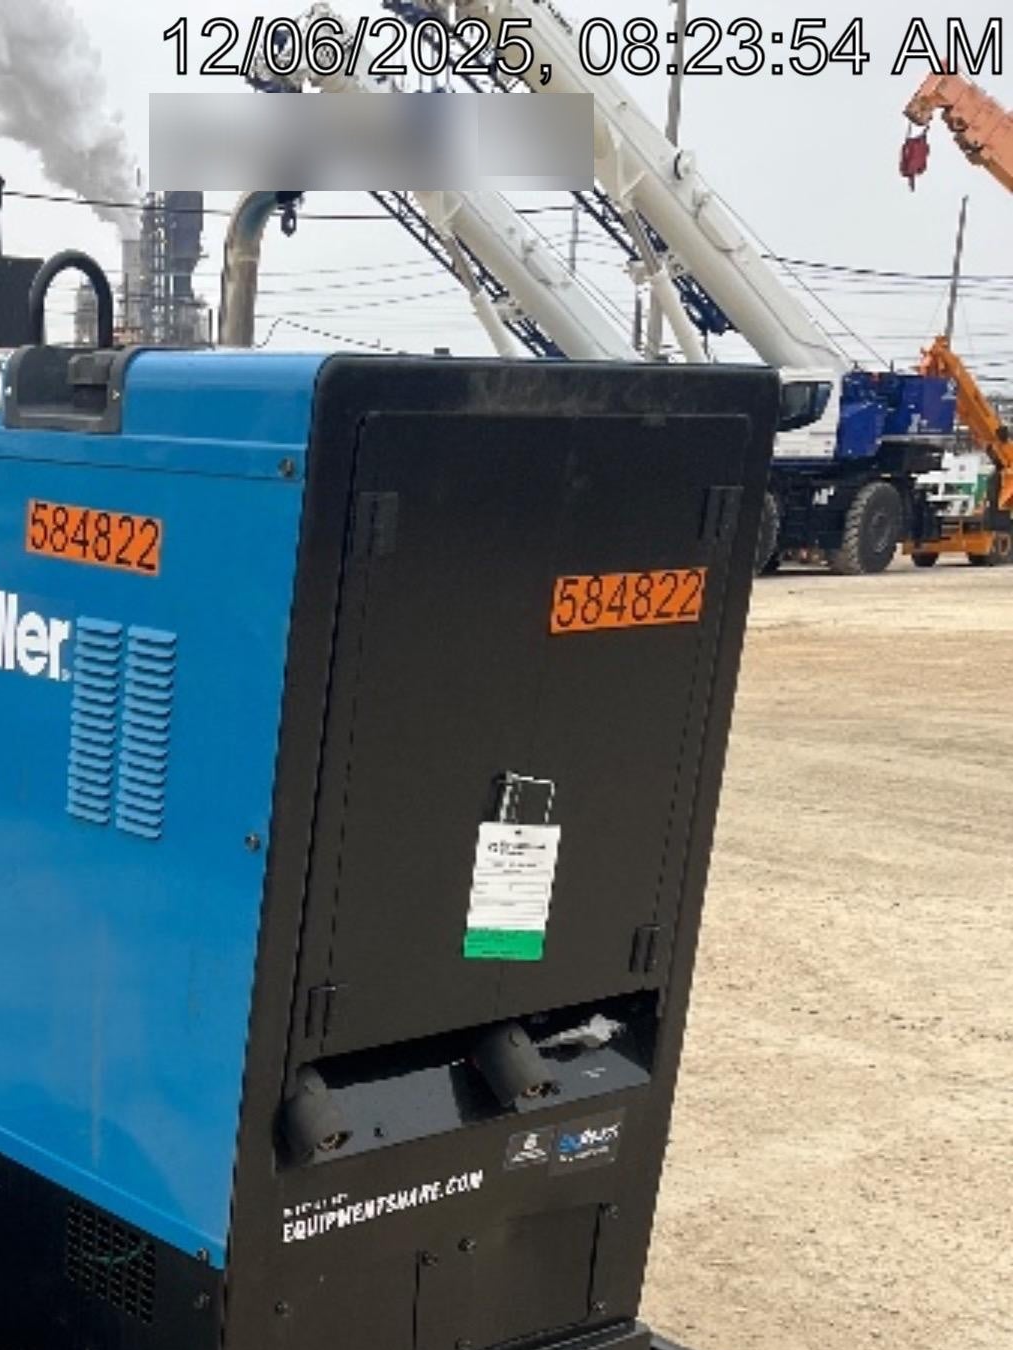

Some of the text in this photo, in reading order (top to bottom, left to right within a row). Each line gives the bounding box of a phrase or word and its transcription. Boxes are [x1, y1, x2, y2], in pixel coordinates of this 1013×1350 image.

[30, 503, 160, 571] 584822
[556, 570, 702, 628] 584822
[283, 1170, 483, 1243] EQUIPMENTSHARE.COM
